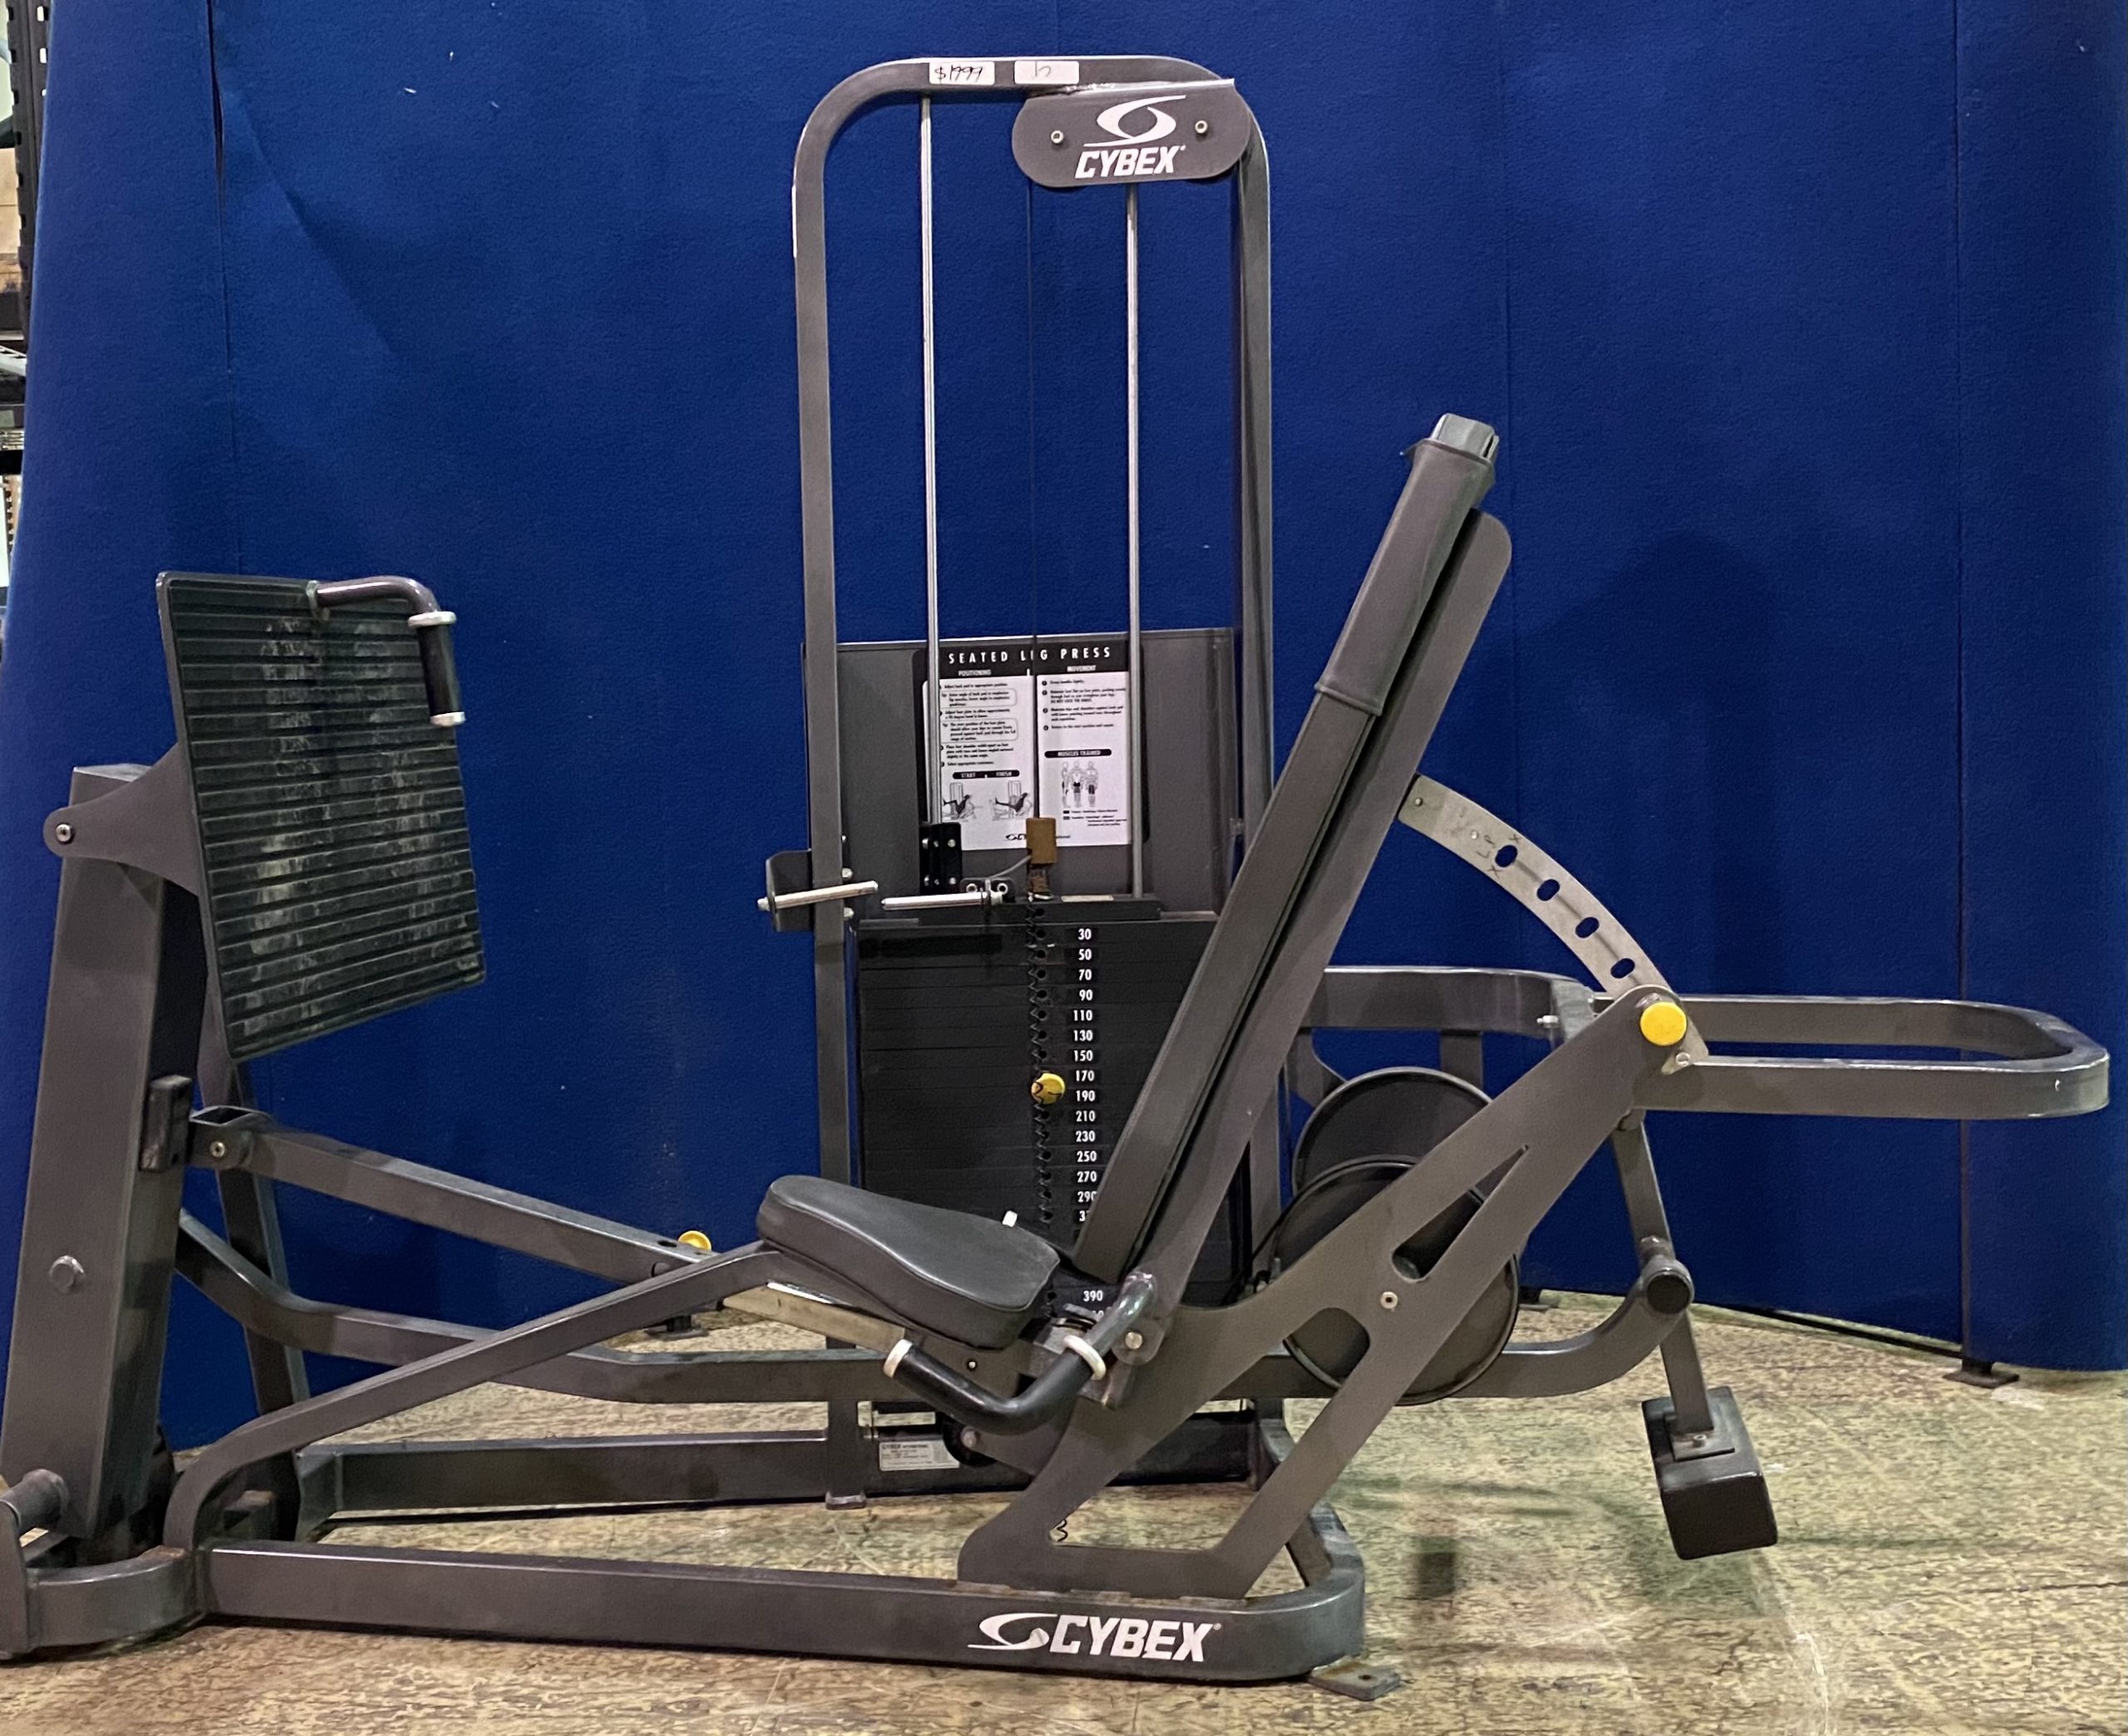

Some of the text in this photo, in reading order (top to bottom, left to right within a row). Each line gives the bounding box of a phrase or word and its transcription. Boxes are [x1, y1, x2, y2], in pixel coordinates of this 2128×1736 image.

[1074, 146, 1181, 180] CYBEX
[948, 652, 1008, 664] SEATED
[1061, 647, 1111, 659] PRESS
[1078, 928, 1091, 940] 30
[1078, 948, 1091, 961] 50
[1079, 969, 1092, 981] 70
[1079, 989, 1093, 1001] 90
[1073, 1010, 1093, 1021] 110
[1074, 1030, 1093, 1041] 130
[1074, 1050, 1093, 1061] 150
[1076, 1070, 1095, 1081] 170
[1076, 1090, 1096, 1102] 190
[1076, 1110, 1096, 1122] 210
[1076, 1130, 1096, 1142] 230
[1076, 1151, 1096, 1162] 250
[1077, 1171, 1097, 1183] 270
[1083, 1290, 1103, 1301] 390
[1050, 1615, 1213, 1662] CYBEX
